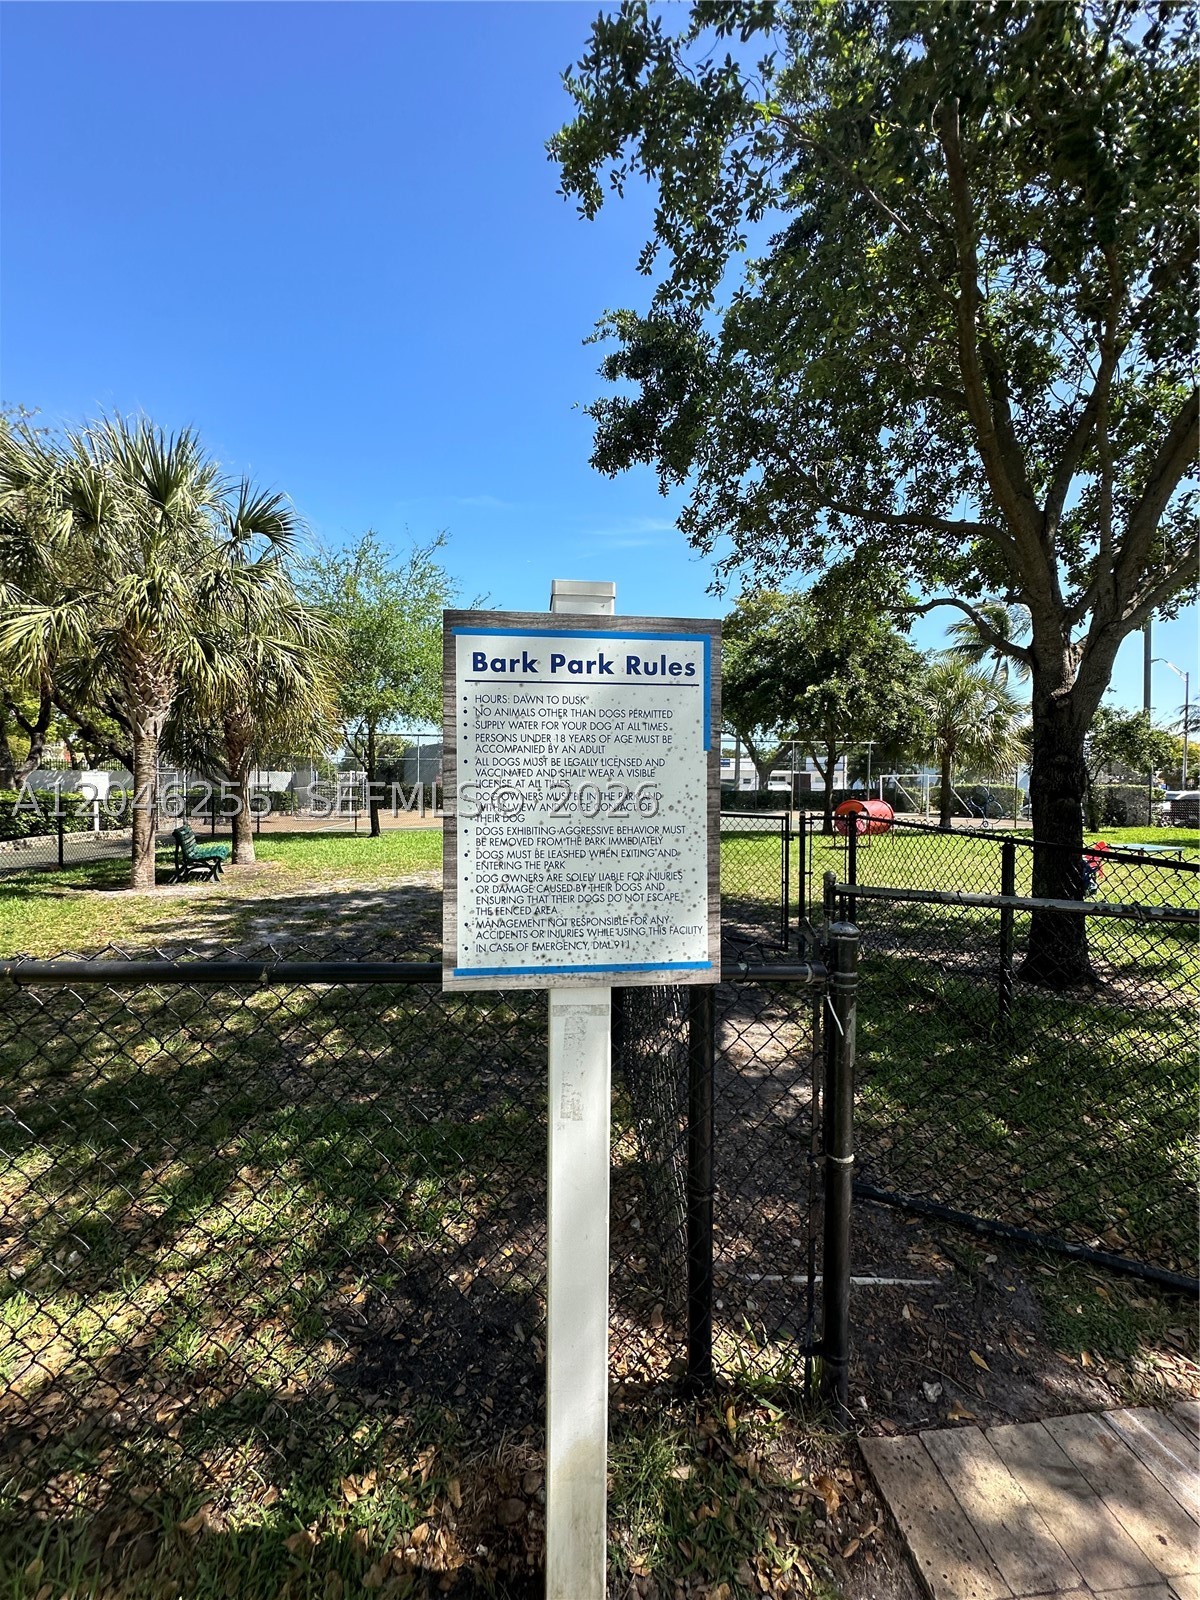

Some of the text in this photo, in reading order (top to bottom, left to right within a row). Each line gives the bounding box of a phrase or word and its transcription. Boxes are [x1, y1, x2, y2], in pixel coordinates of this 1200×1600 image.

[472, 651, 696, 676] Bark Park Rules
[475, 695, 585, 705] HOURS: DAWN TO DUSK
[475, 708, 673, 718] NO ANIMALS OTHER THAN DOGS PERMITTED
[475, 721, 668, 731] SUPPLY WATER FOR YOUR DOG AT ALL TIMES
[475, 734, 672, 744] PERSONS UNDER 18 YEARS OF AGE MUST BE
[475, 745, 605, 754] ACCOMPANIED BY AN ADULT
[475, 758, 665, 767] ALL DOGS MUST BE LEGALLY LICENSED AND
[475, 769, 655, 778] VACCINATED AND SHALL WEAR A VISIBLE
[515, 780, 525, 788] AT
[528, 780, 542, 788] ALL
[502, 792, 543, 800] OWNERS
[546, 792, 572, 800] MUS
[587, 792, 597, 800] IN
[601, 792, 615, 800] THE
[619, 792, 639, 800] PAR
[514, 803, 537, 812] VEW
[540, 803, 560, 811] AN
[564, 803, 591, 811] VOCE
[639, 803, 652, 811] OF
[503, 814, 525, 823] DOG
[476, 825, 685, 835] DOGS EXHIBITING AGGRESSIVE BEHAVIOR MUST
[476, 837, 663, 846] BE REMOVED FROM THE PARK IMMEDIATELY
[476, 849, 677, 859] DOGS MUST BE LEASHED WHEN EXITING AND
[476, 861, 565, 870] ENTERING THE PARK
[476, 872, 682, 883] DOG OWNERS ARE SOLELY LIABLE FOR INJURIES
[476, 883, 665, 894] OR DAMAGE CAUSED BY THEIR DOGS AND
[476, 893, 679, 904] ENSURING THAT THEIR DOGS DO NOT ESCAPE
[476, 906, 557, 916] THE FENCED AREA
[476, 916, 669, 928] MANAGEMENT NOT RESPONSIBLE FOR ANY
[476, 926, 703, 939] ACCIDENTS OR INJURIES WHILE USING THIS FACILITY
[476, 940, 630, 952] IN CASE OF EMERGENCY, DIAL 911
